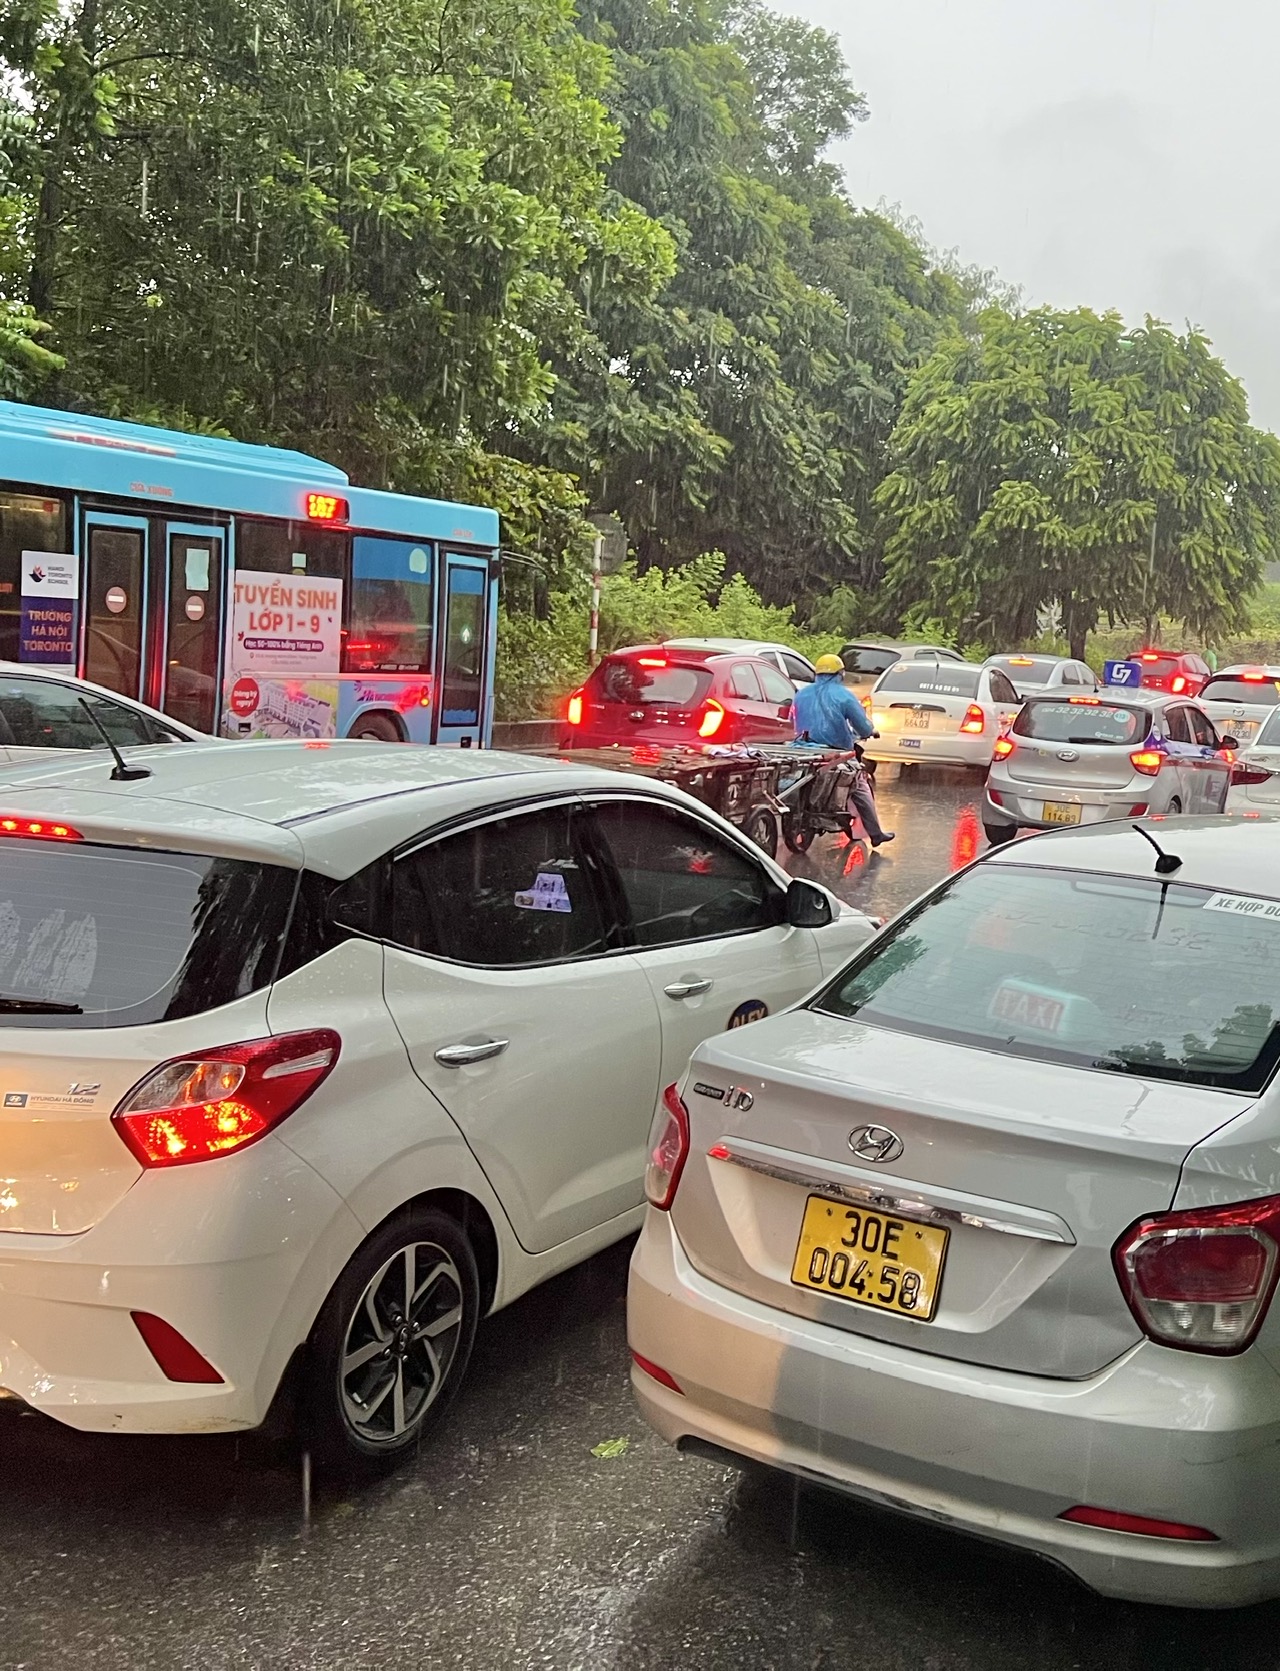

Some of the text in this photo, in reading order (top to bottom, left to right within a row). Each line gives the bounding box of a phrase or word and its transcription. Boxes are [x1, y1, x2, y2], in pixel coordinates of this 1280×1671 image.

[235, 579, 337, 610] TUYỂN SINH
[249, 608, 283, 632] LỚP
[287, 613, 293, 632] 1
[310, 615, 320, 634] 9
[23, 640, 74, 652] TORONTO
[1112, 663, 1132, 684] G7
[1055, 706, 1070, 714] 32
[1070, 707, 1084, 715] 32
[1084, 709, 1099, 717] 32
[1099, 710, 1114, 718] 32
[1214, 897, 1236, 909] XE
[1235, 900, 1264, 914] HỢP
[999, 987, 1061, 1030] TAXI
[841, 1210, 905, 1261] 30E
[808, 1246, 922, 1310] 004.58
